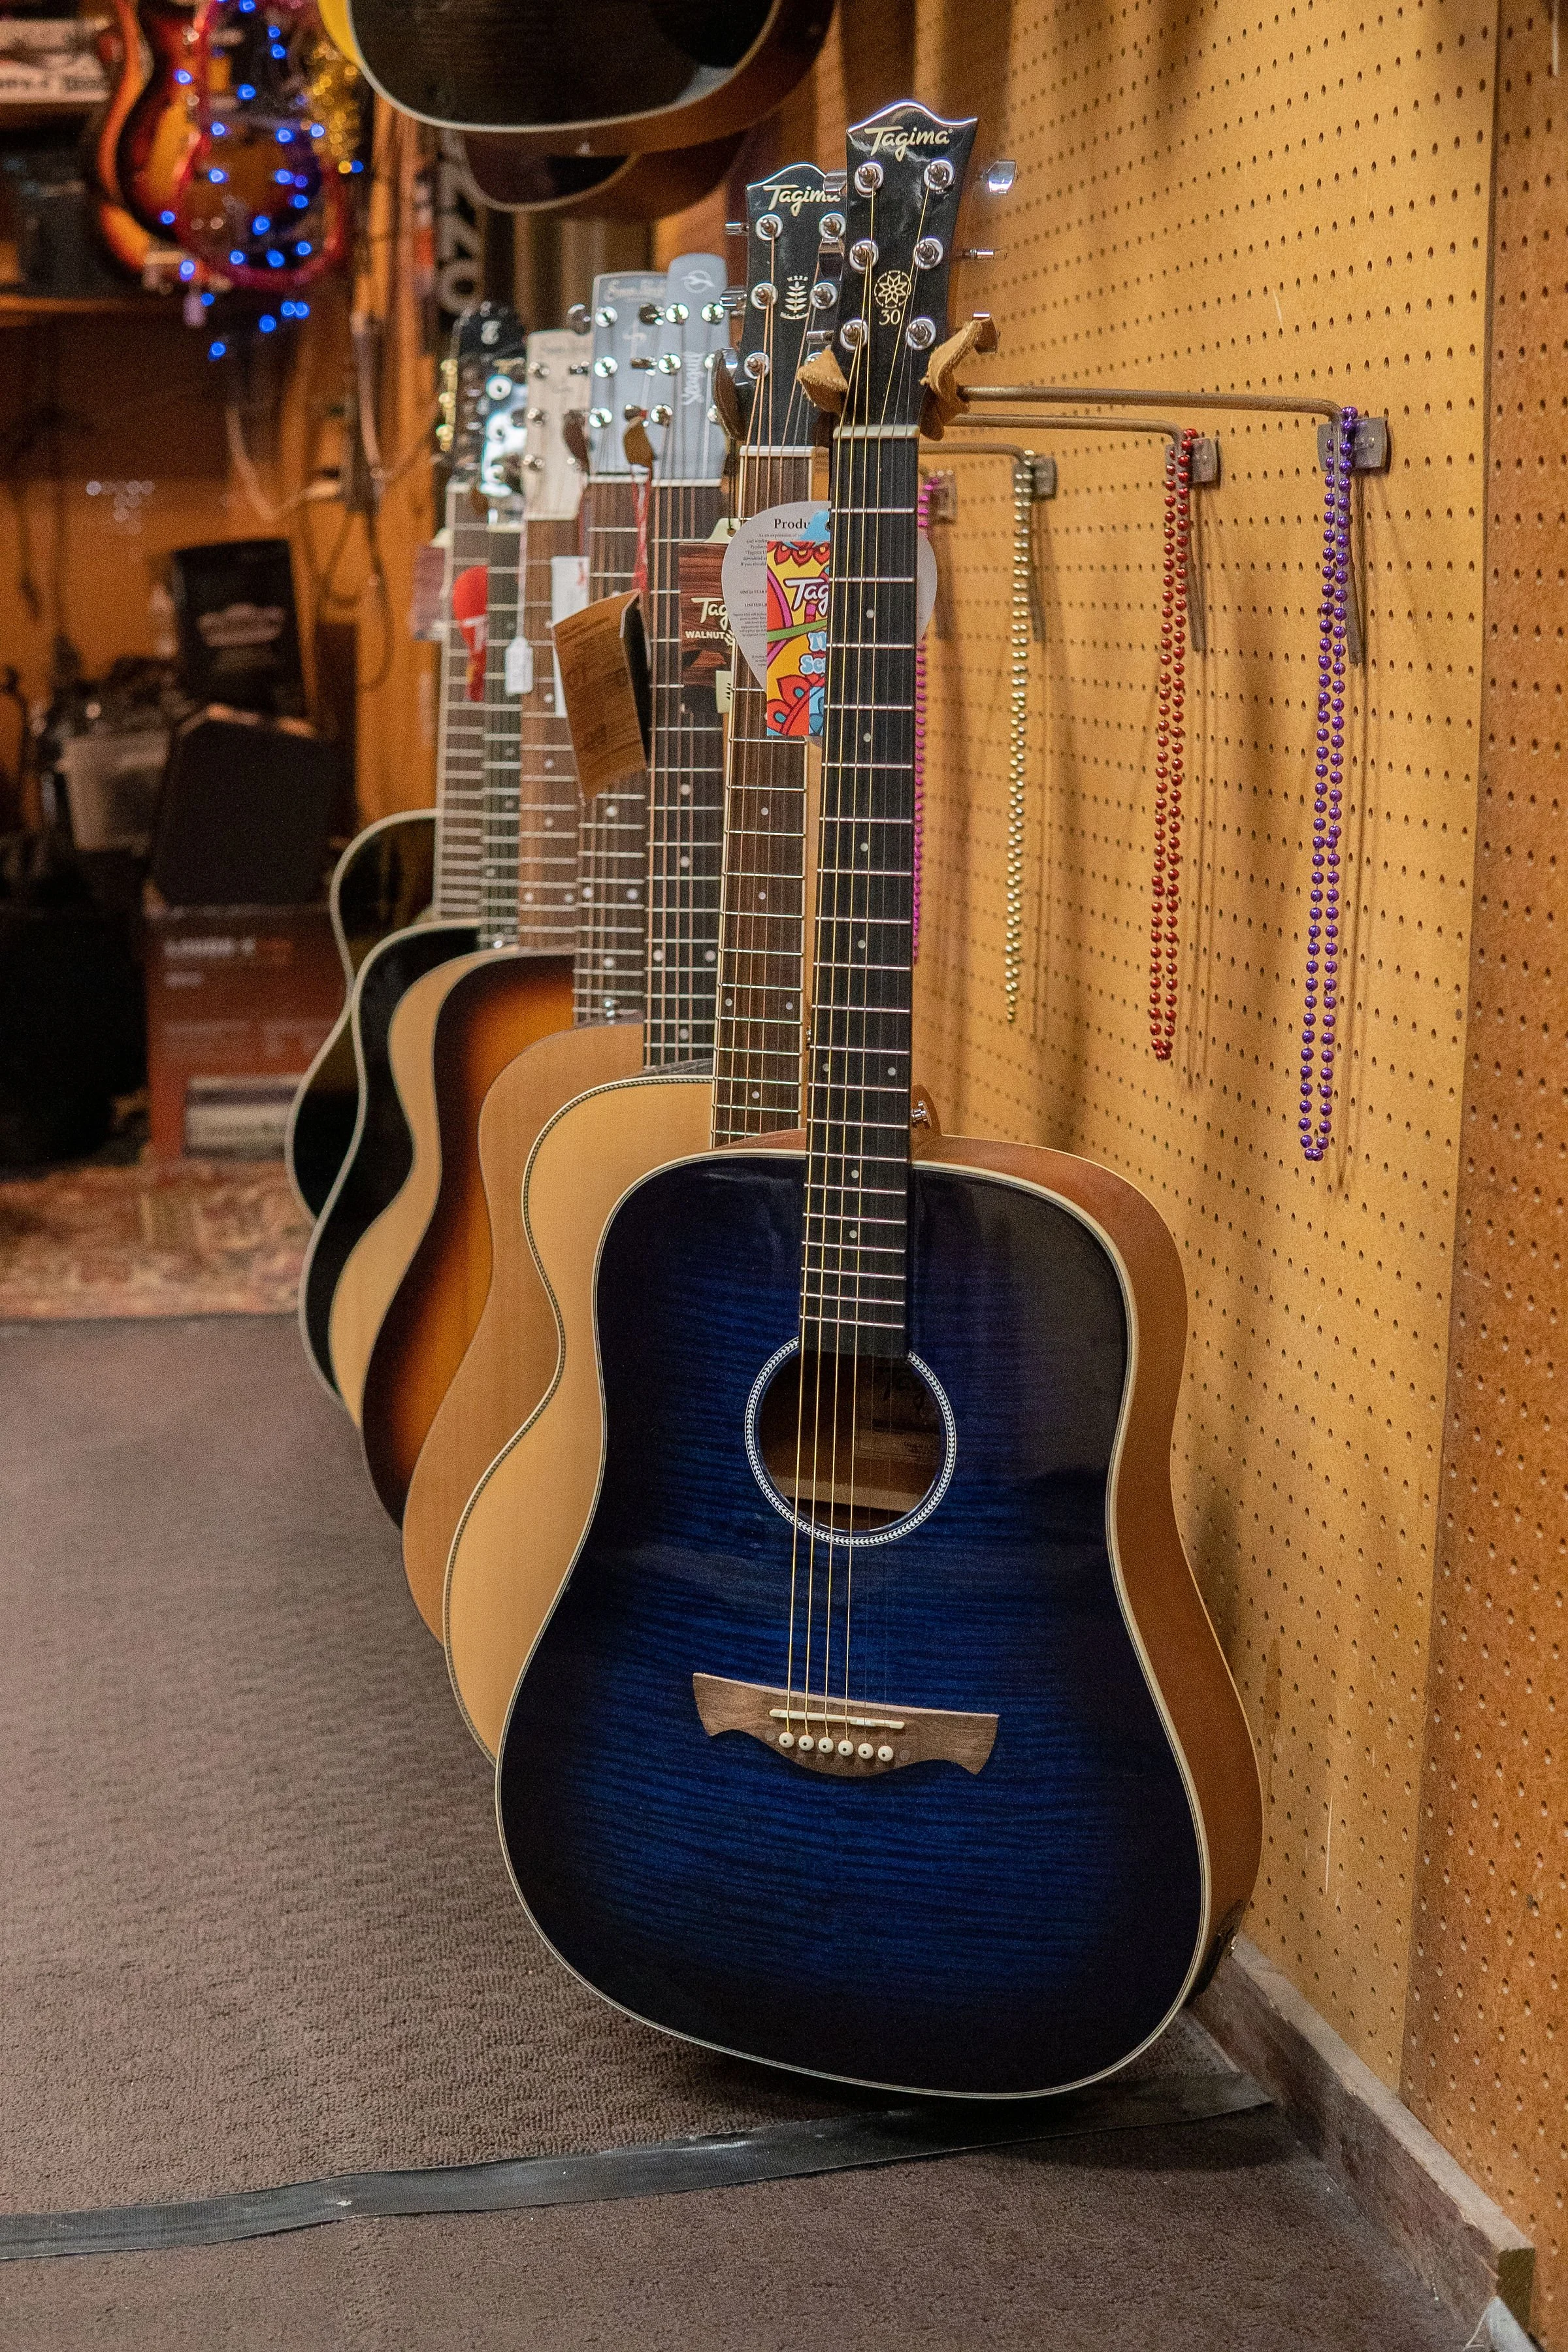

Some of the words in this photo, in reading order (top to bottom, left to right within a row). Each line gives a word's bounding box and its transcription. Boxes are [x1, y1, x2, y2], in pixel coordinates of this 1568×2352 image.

[864, 125, 951, 161] Tagima
[879, 308, 901, 326] 30
[685, 630, 725, 640] WALNUT
[798, 653, 826, 675] Se
